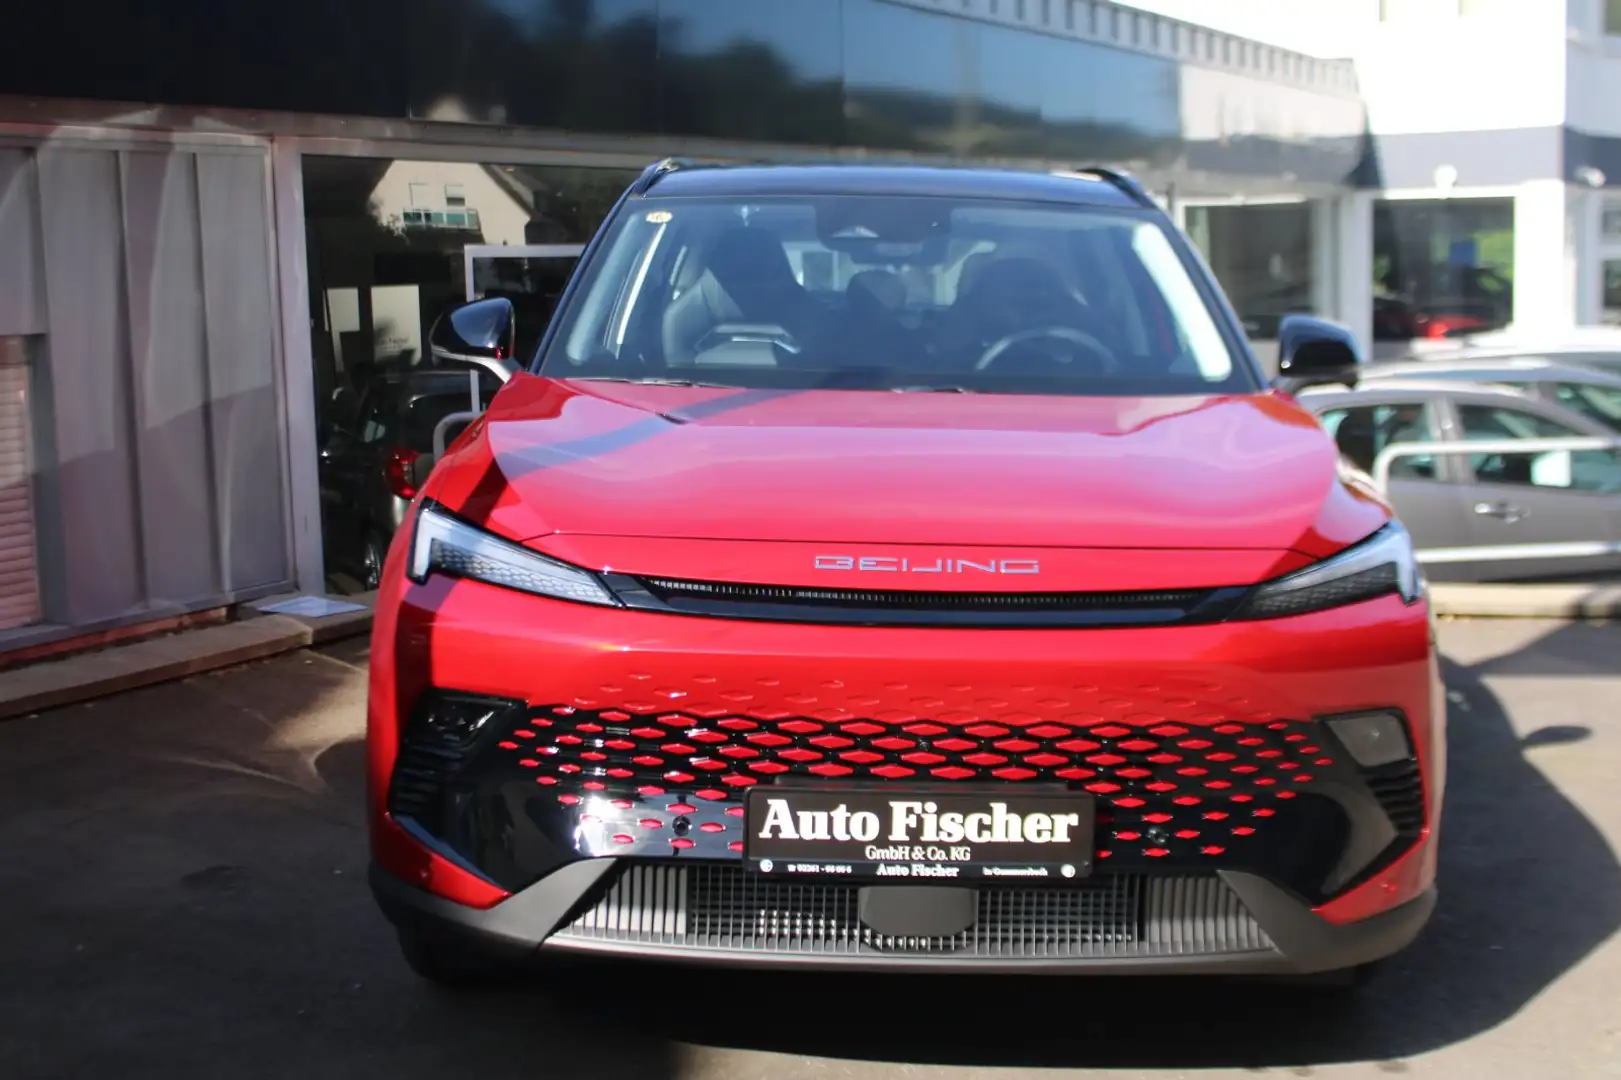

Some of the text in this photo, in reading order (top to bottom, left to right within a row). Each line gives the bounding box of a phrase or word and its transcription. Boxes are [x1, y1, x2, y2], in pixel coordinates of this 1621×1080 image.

[815, 555, 1039, 574] BEIJING
[758, 798, 1079, 843] Auto Fischer
[865, 845, 971, 861] GmbH & Co. KG
[876, 863, 960, 877] Auto Fischer
